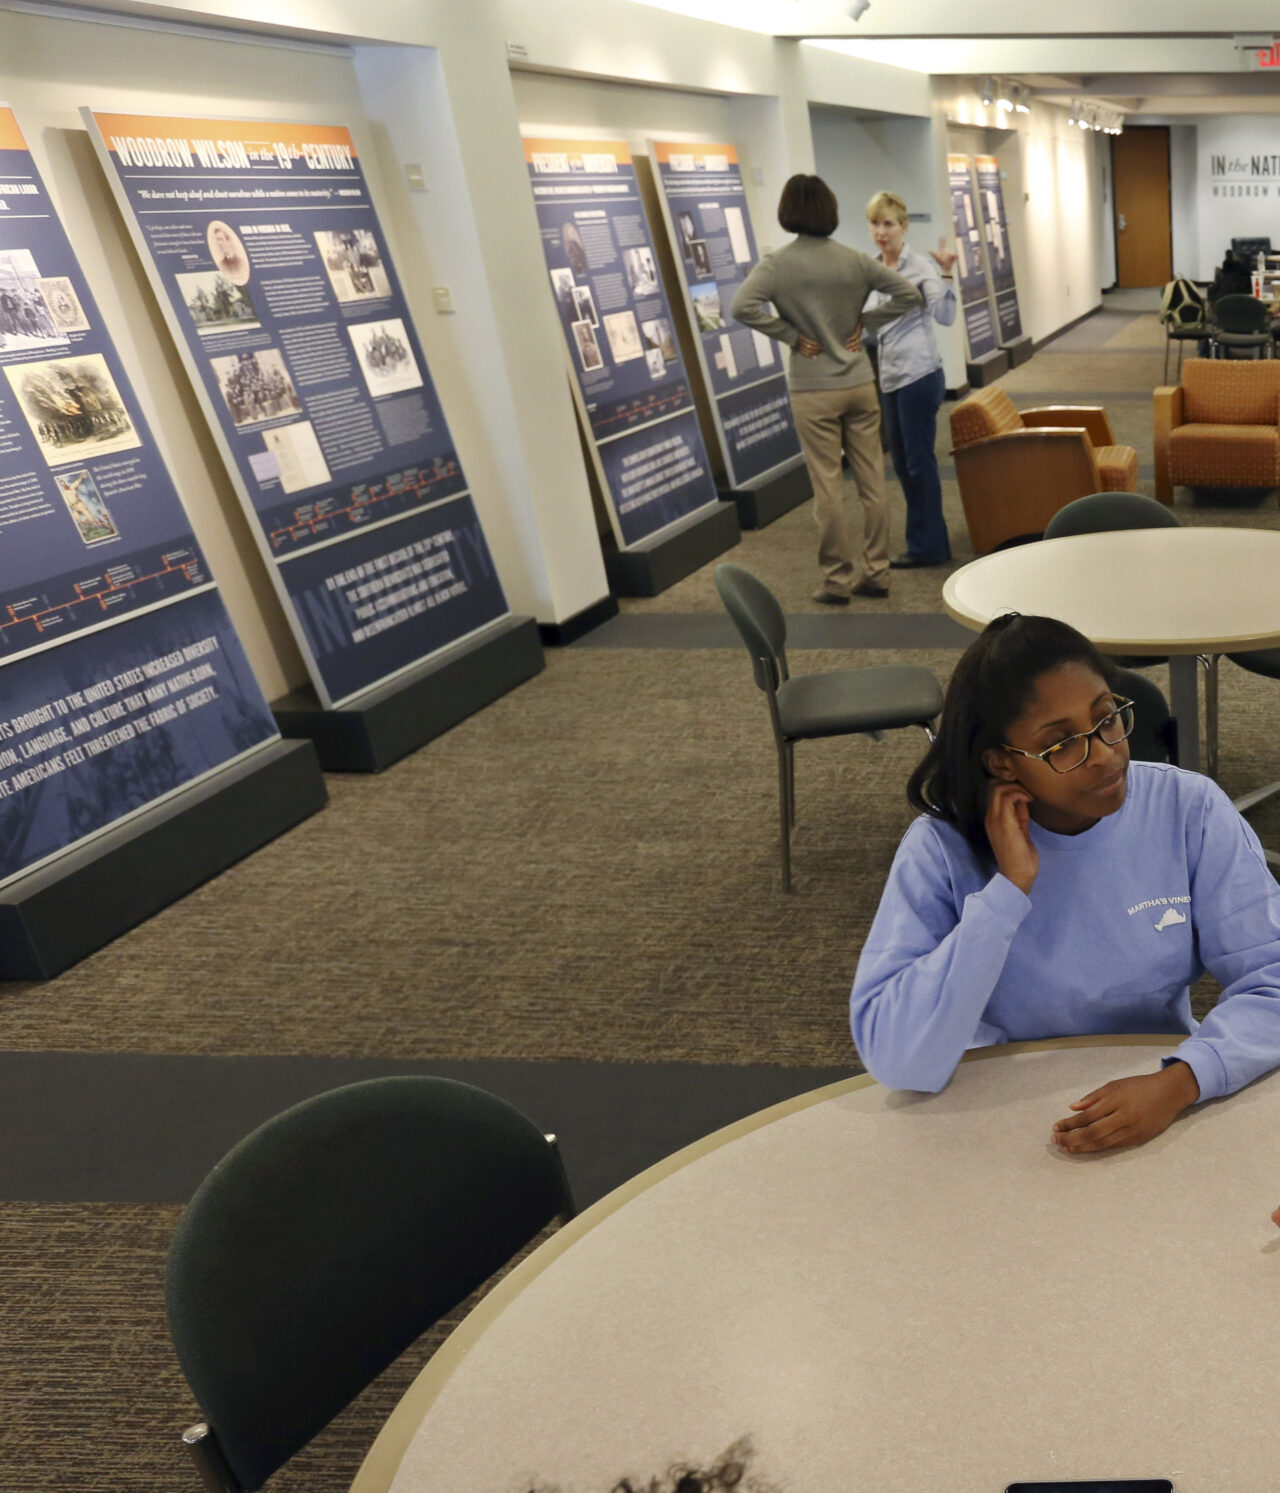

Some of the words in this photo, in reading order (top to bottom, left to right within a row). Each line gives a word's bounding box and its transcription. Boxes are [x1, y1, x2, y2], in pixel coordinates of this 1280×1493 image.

[110, 136, 195, 168] WOODROW
[192, 138, 251, 169] WILSON
[301, 143, 355, 171] CENTURY
[1211, 155, 1226, 176] IN
[1227, 157, 1249, 173] the
[1212, 185, 1269, 198] WOODROW
[11, 702, 55, 734] BROUGHT
[53, 698, 69, 717] TO
[66, 692, 87, 711] THE
[83, 680, 116, 704] UNITED
[113, 667, 145, 692] STATES
[141, 650, 185, 679] INCREASED
[181, 635, 220, 662] DIVERSITY
[19, 726, 73, 759] LANGUAGE,
[70, 717, 92, 736] AND
[88, 703, 128, 731] CULTURE
[123, 694, 146, 713] THAT
[144, 682, 169, 703] MANY
[12, 756, 66, 792] AMERICANS
[63, 746, 86, 768] FELT
[83, 723, 136, 758] THREATENED
[133, 716, 152, 735] THE
[148, 703, 179, 729] FABRIC
[175, 701, 188, 715] OF
[185, 685, 220, 710] SOCIETY.
[1127, 897, 1168, 916] MARTHA'S
[1168, 896, 1192, 904] VINE
